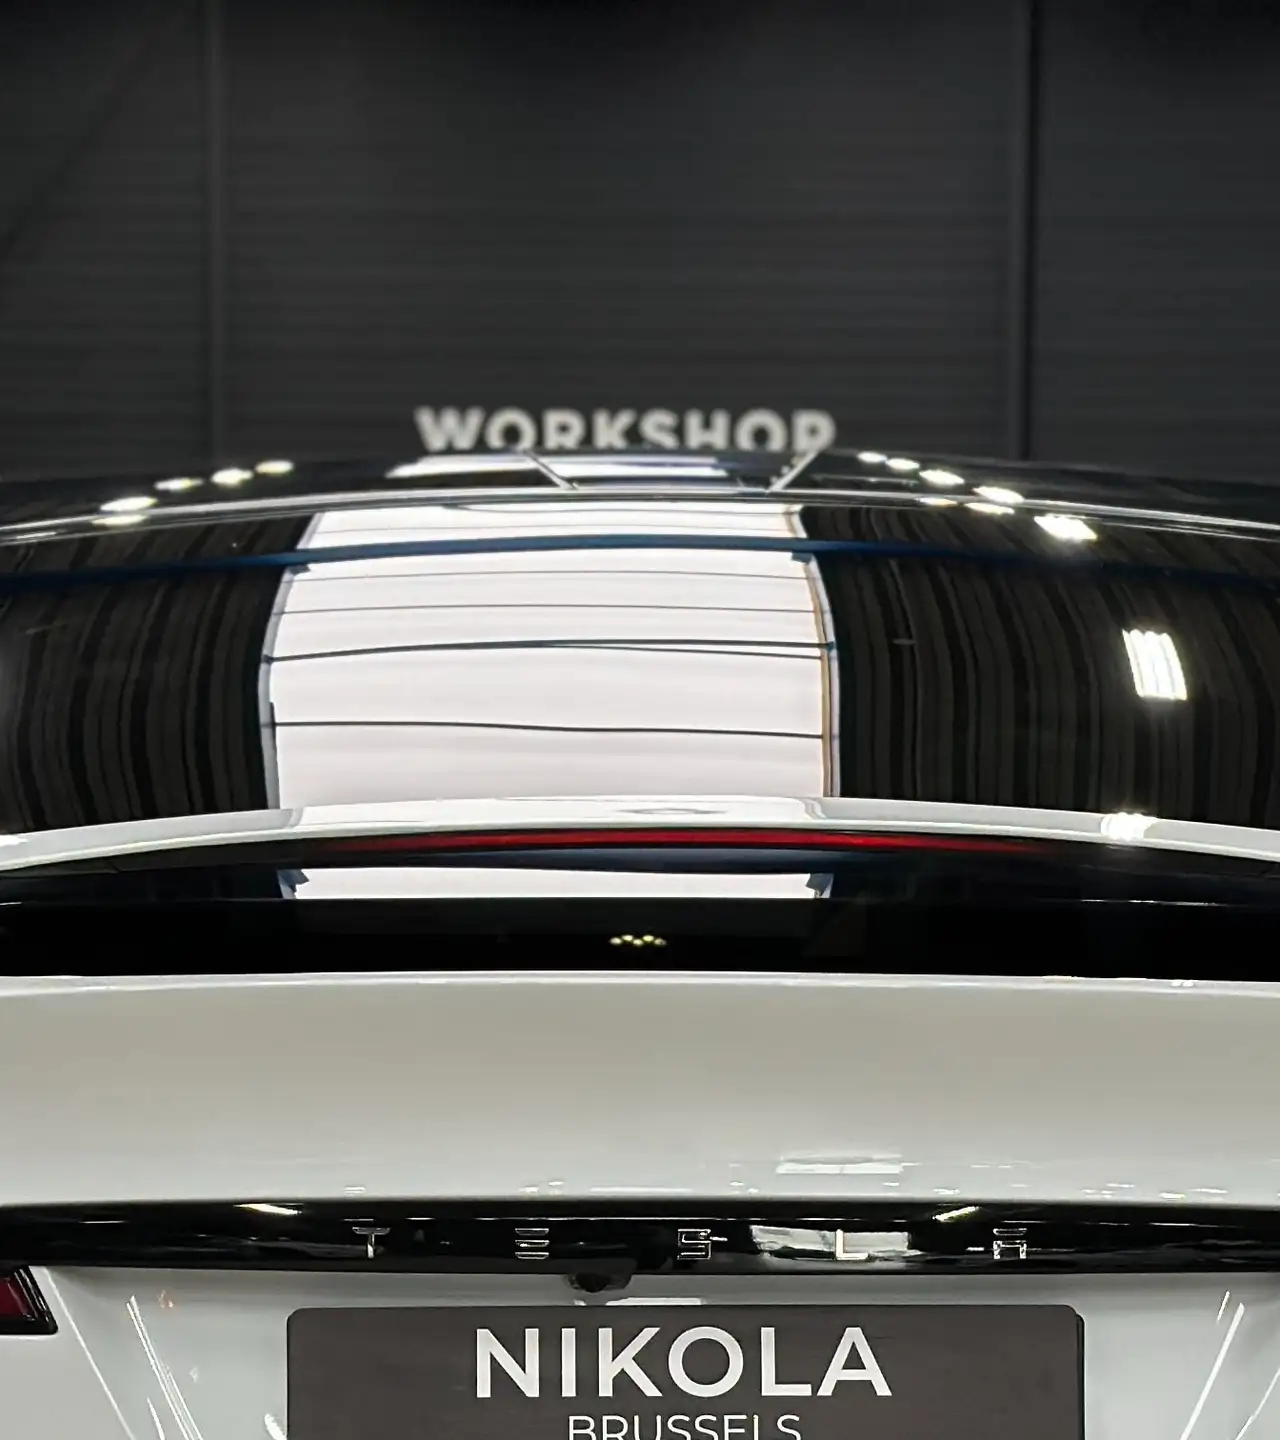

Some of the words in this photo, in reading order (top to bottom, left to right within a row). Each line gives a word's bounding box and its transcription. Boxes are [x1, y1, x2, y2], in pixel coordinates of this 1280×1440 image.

[414, 405, 837, 452] WORKSHOP
[351, 1226, 1028, 1261] TESLA
[477, 1326, 893, 1398] NIKOLA
